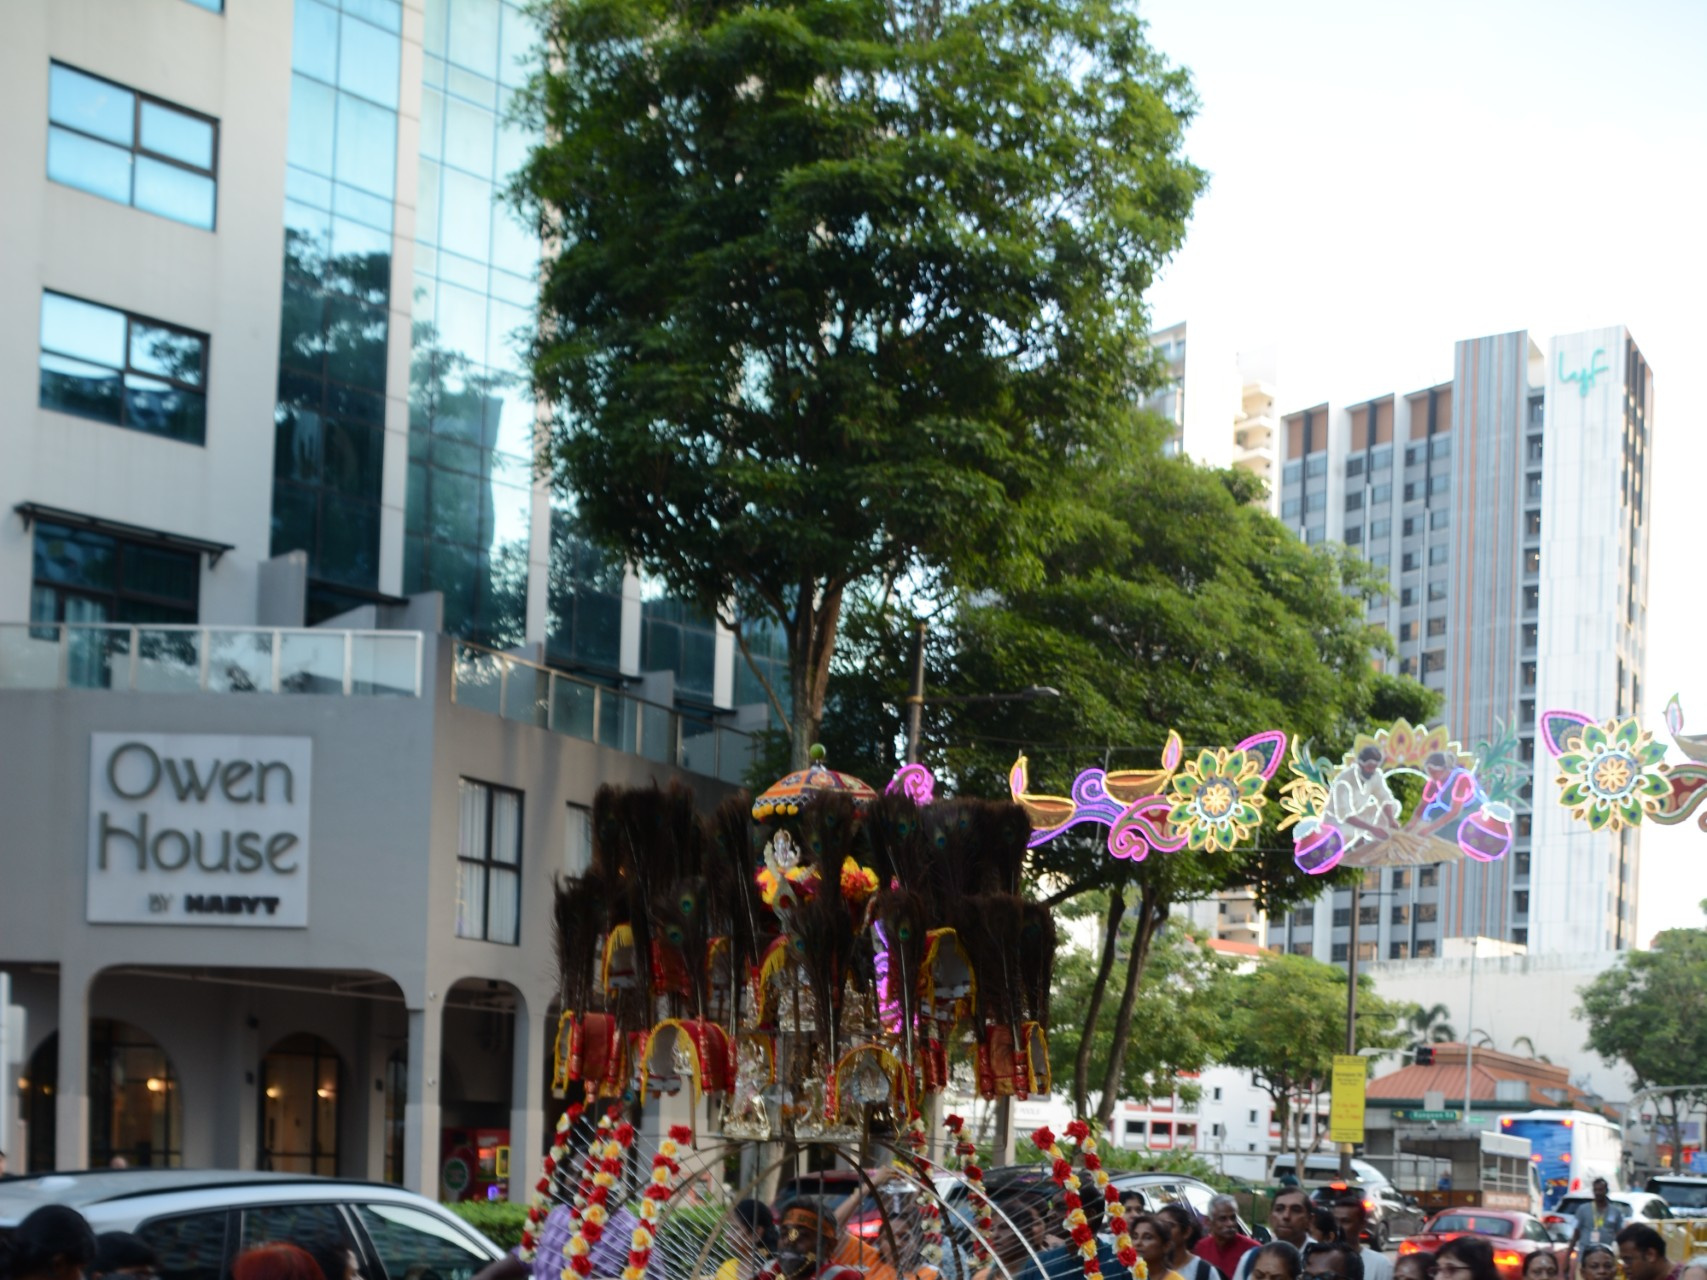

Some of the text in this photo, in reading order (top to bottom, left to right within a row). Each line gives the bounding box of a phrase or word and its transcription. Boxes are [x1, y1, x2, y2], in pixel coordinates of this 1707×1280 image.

[1558, 347, 1609, 398] lyf
[106, 741, 294, 803] Owen
[98, 811, 299, 875] House
[148, 893, 173, 913] BY
